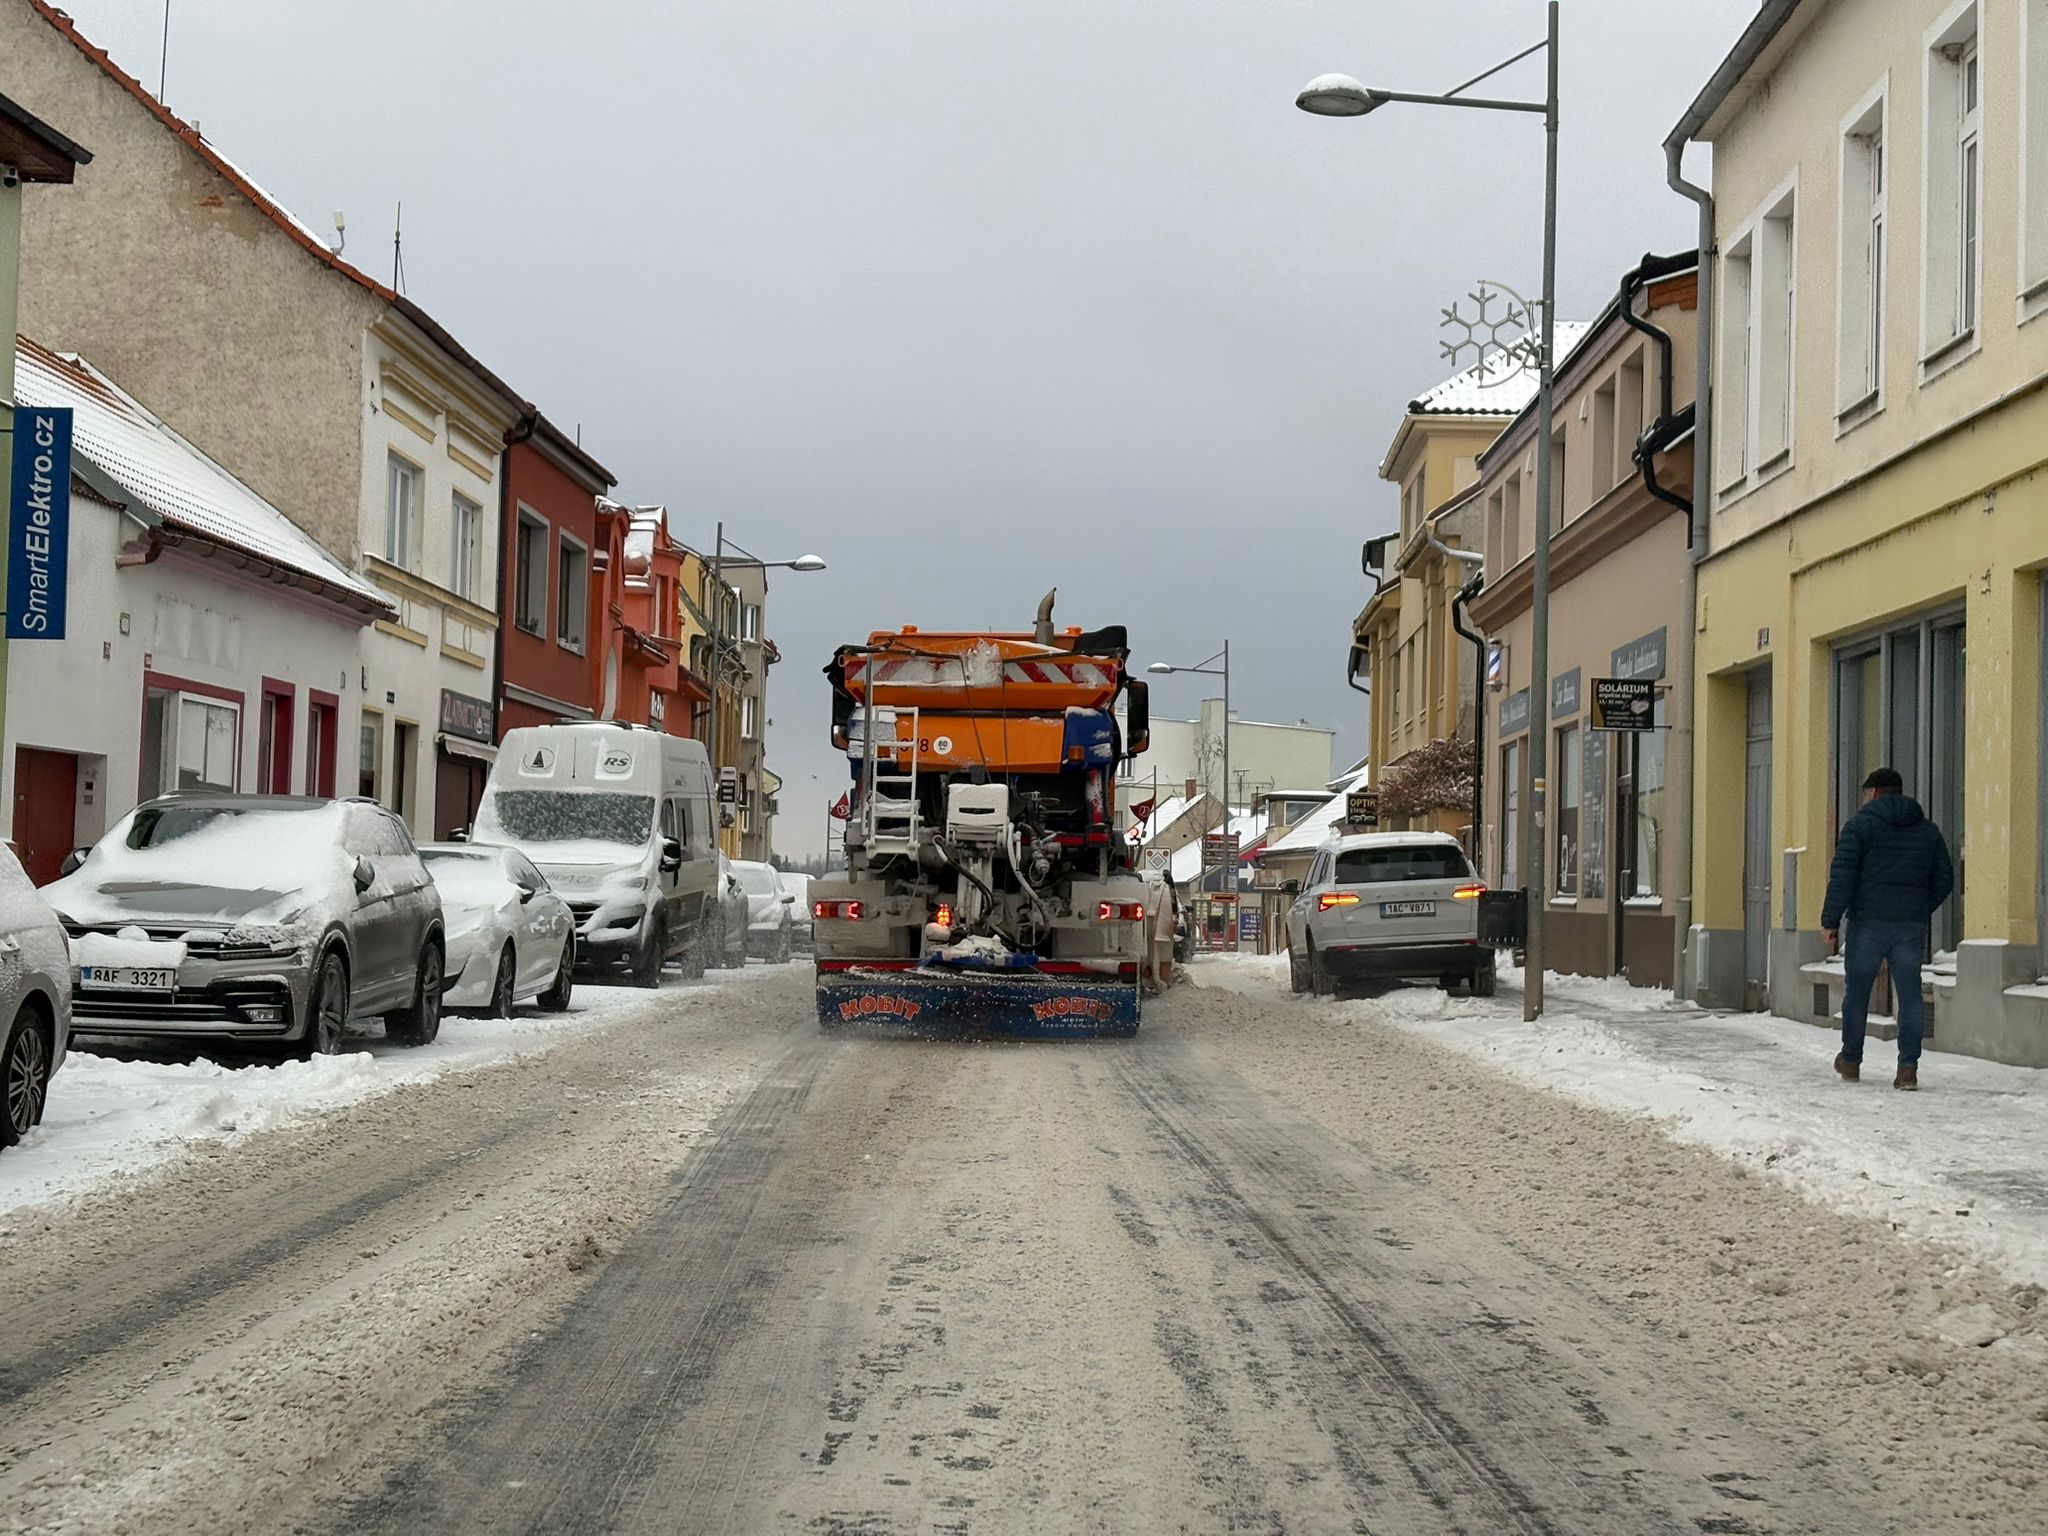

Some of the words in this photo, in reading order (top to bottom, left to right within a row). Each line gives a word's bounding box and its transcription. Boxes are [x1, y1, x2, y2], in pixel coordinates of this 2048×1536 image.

[22, 415, 54, 632] SmartElektro.cz
[1598, 682, 1649, 693] SOLÁRIUM
[603, 757, 629, 766] RS
[1388, 904, 1404, 913] 1AC
[1409, 903, 1431, 912] V871
[130, 971, 167, 987] 3321
[838, 994, 921, 1021] KOBIT
